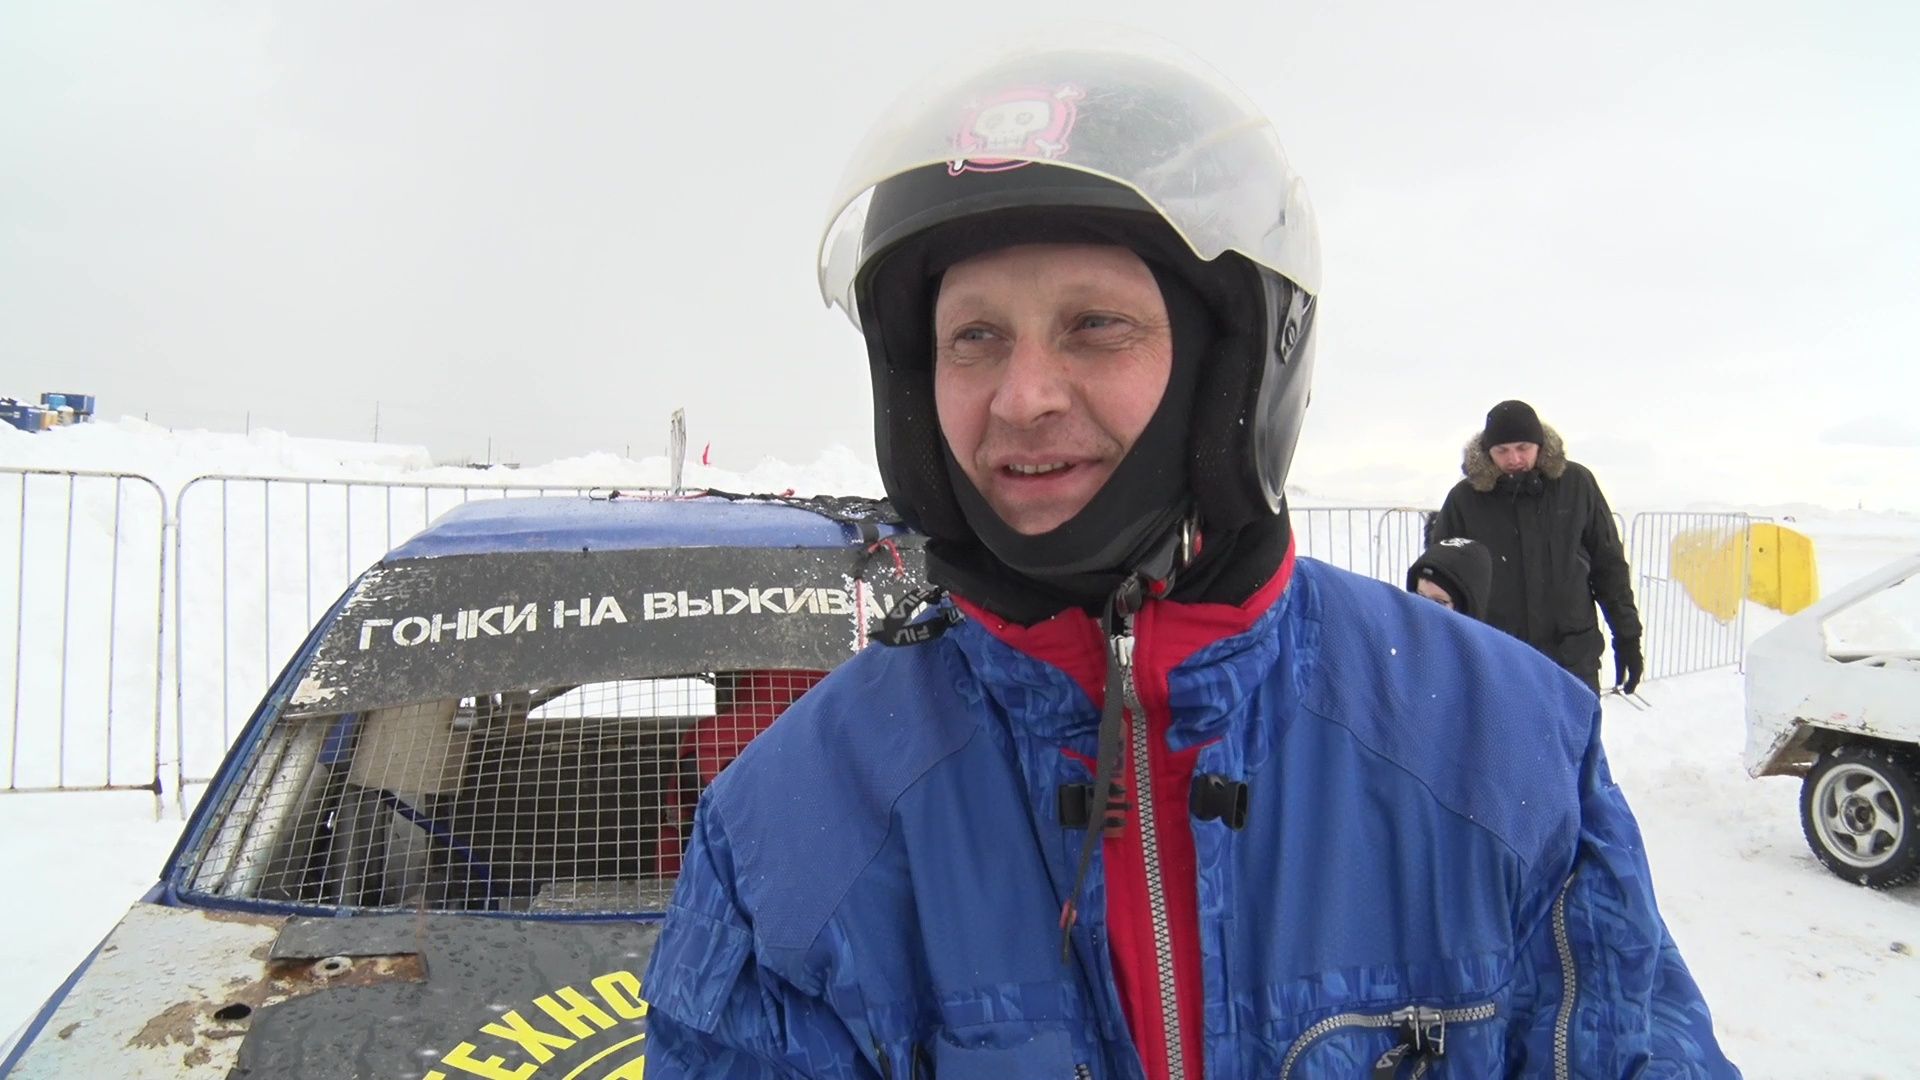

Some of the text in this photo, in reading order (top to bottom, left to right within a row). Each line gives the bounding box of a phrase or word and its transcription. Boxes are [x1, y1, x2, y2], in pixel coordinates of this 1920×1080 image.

[358, 602, 538, 650] ГОНКИ
[553, 596, 629, 629] НА
[422, 970, 649, 1080] ЕХНО
